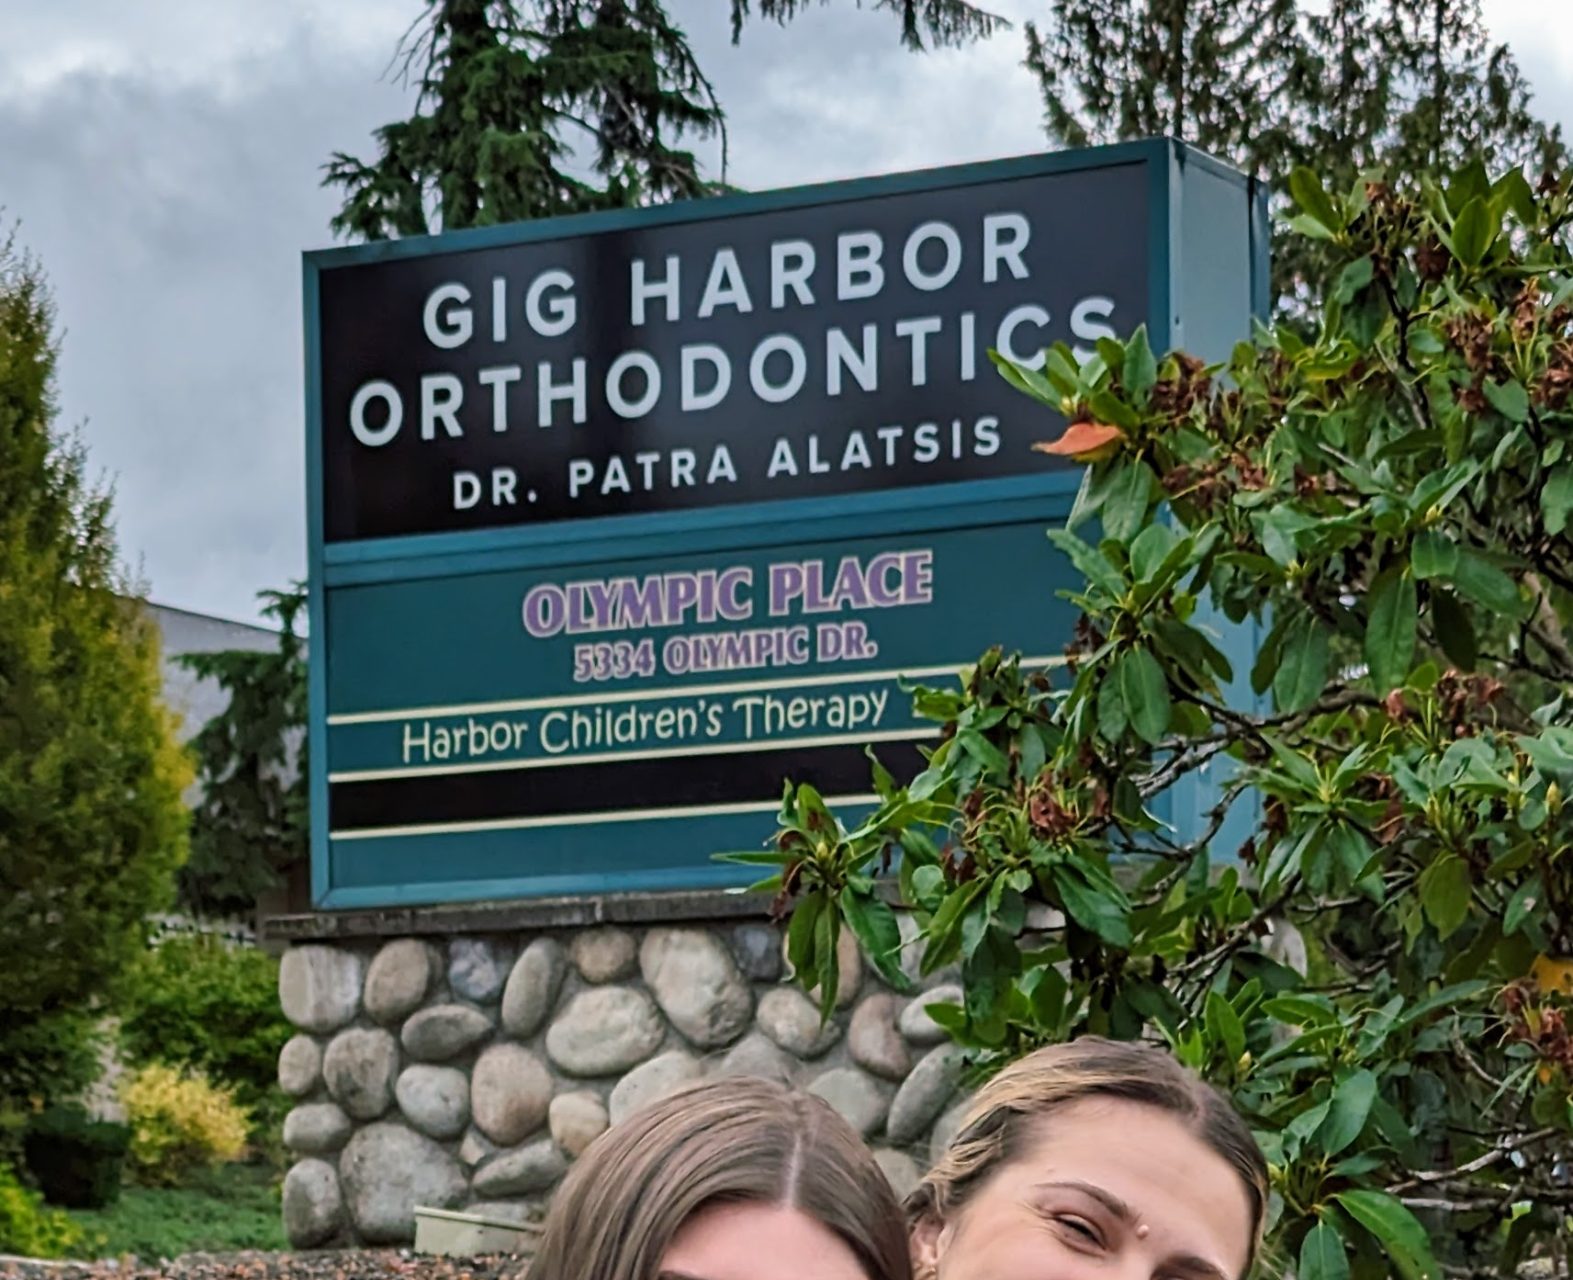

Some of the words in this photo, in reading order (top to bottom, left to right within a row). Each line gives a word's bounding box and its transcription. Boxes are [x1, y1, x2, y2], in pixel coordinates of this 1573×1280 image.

[423, 270, 576, 349] GIG
[631, 213, 1031, 326] HARBOR
[350, 297, 1116, 446] ORTHODONTICS
[453, 470, 537, 509] DR.
[569, 445, 737, 498] PATRA
[767, 417, 1000, 478] ALATSIS
[522, 567, 752, 638] OLYMPIC
[769, 549, 933, 617] PLACE
[573, 640, 656, 683] 5334
[662, 629, 810, 675] OLYMPIC
[816, 620, 878, 661] DR.
[402, 720, 528, 764] Harbor
[539, 702, 722, 754] Children's
[732, 689, 888, 739] Therapy
